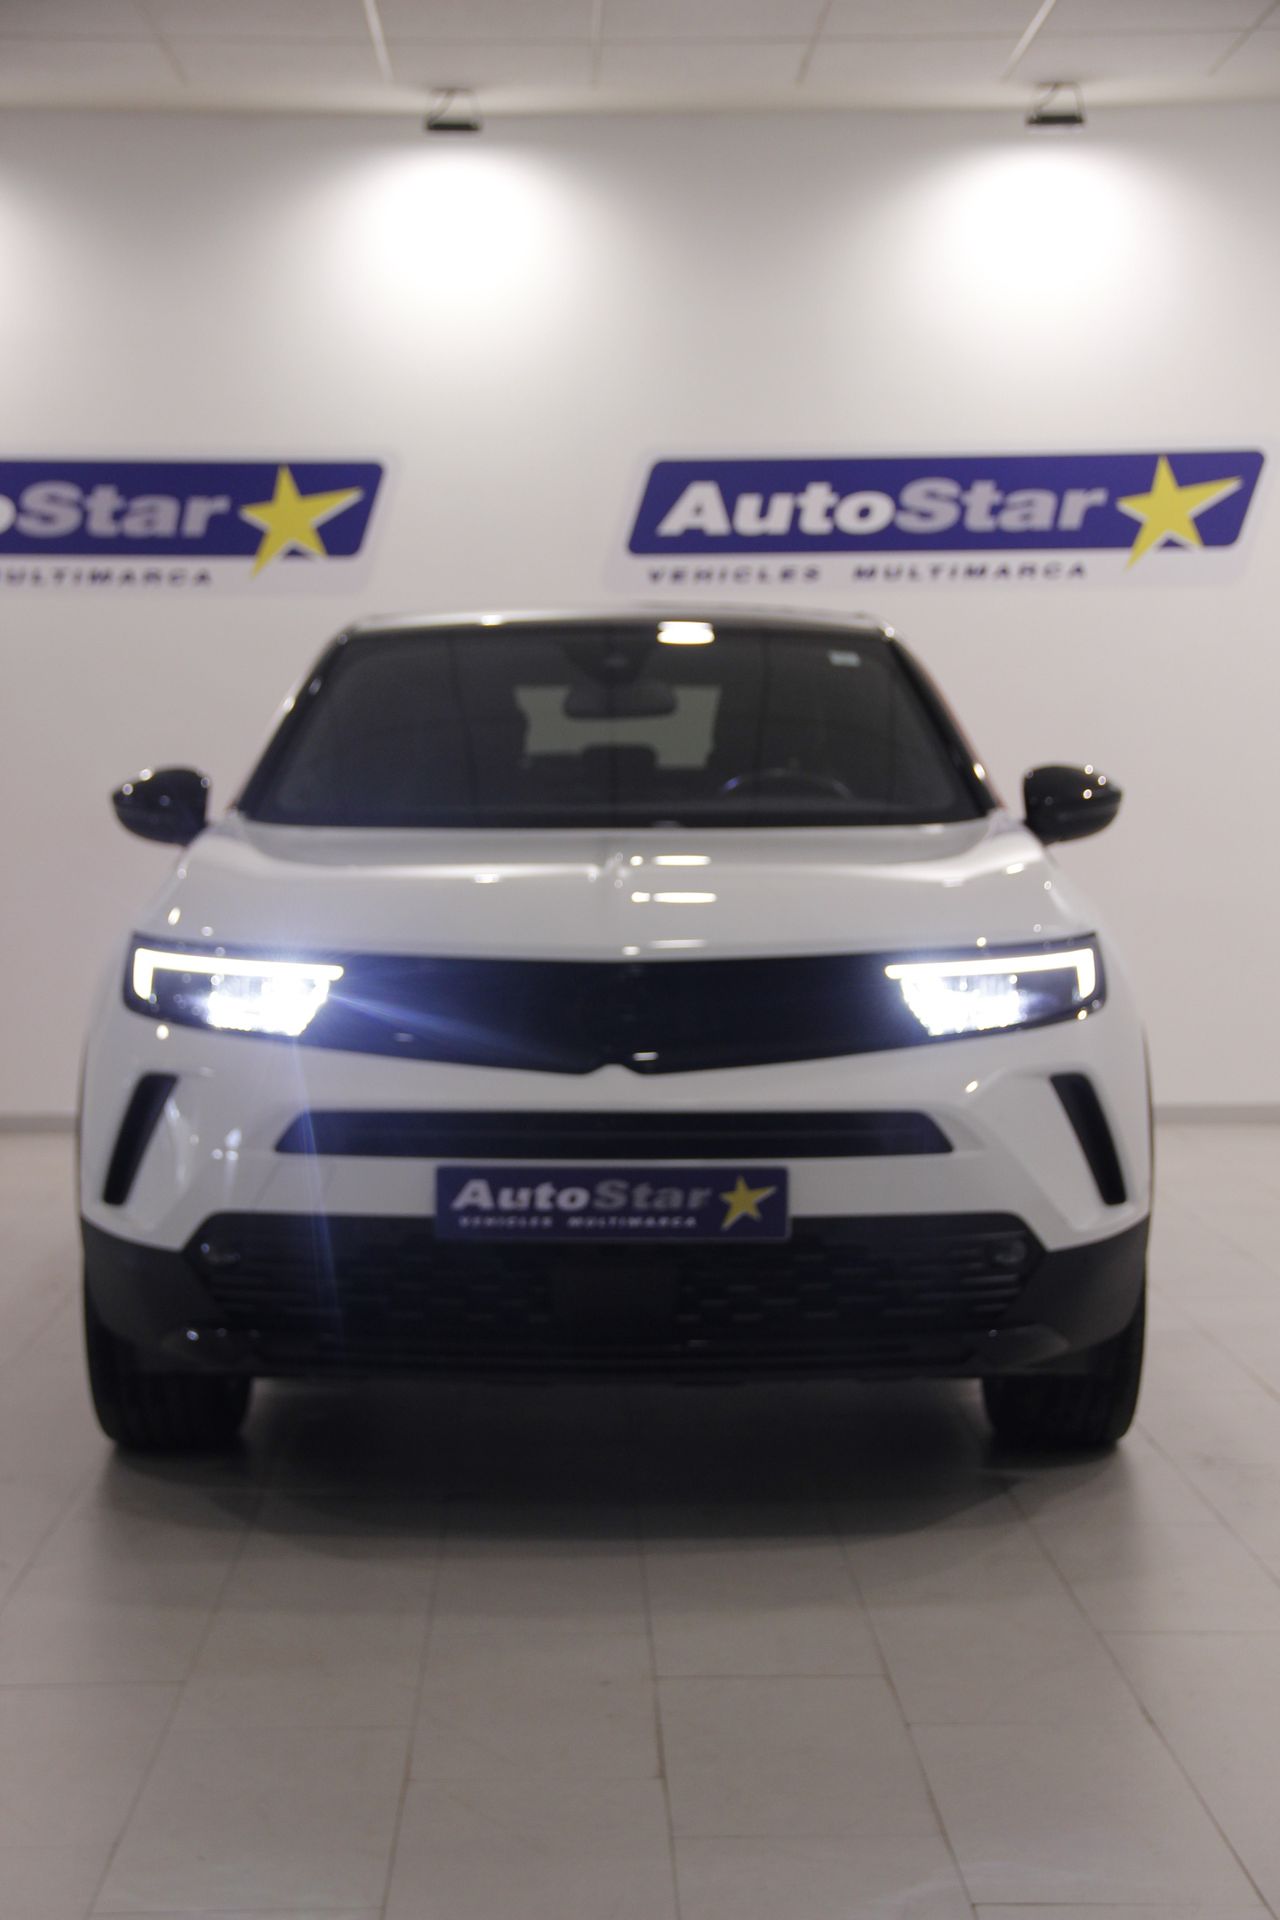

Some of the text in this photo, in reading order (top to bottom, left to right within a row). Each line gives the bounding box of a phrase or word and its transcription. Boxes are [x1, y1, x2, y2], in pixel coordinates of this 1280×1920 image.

[656, 477, 1107, 537] AutoStar
[0, 568, 213, 588] ULTIMARCA
[648, 562, 1088, 584] VEHICLES MULTIMARCA
[452, 1178, 712, 1211] AutoStar
